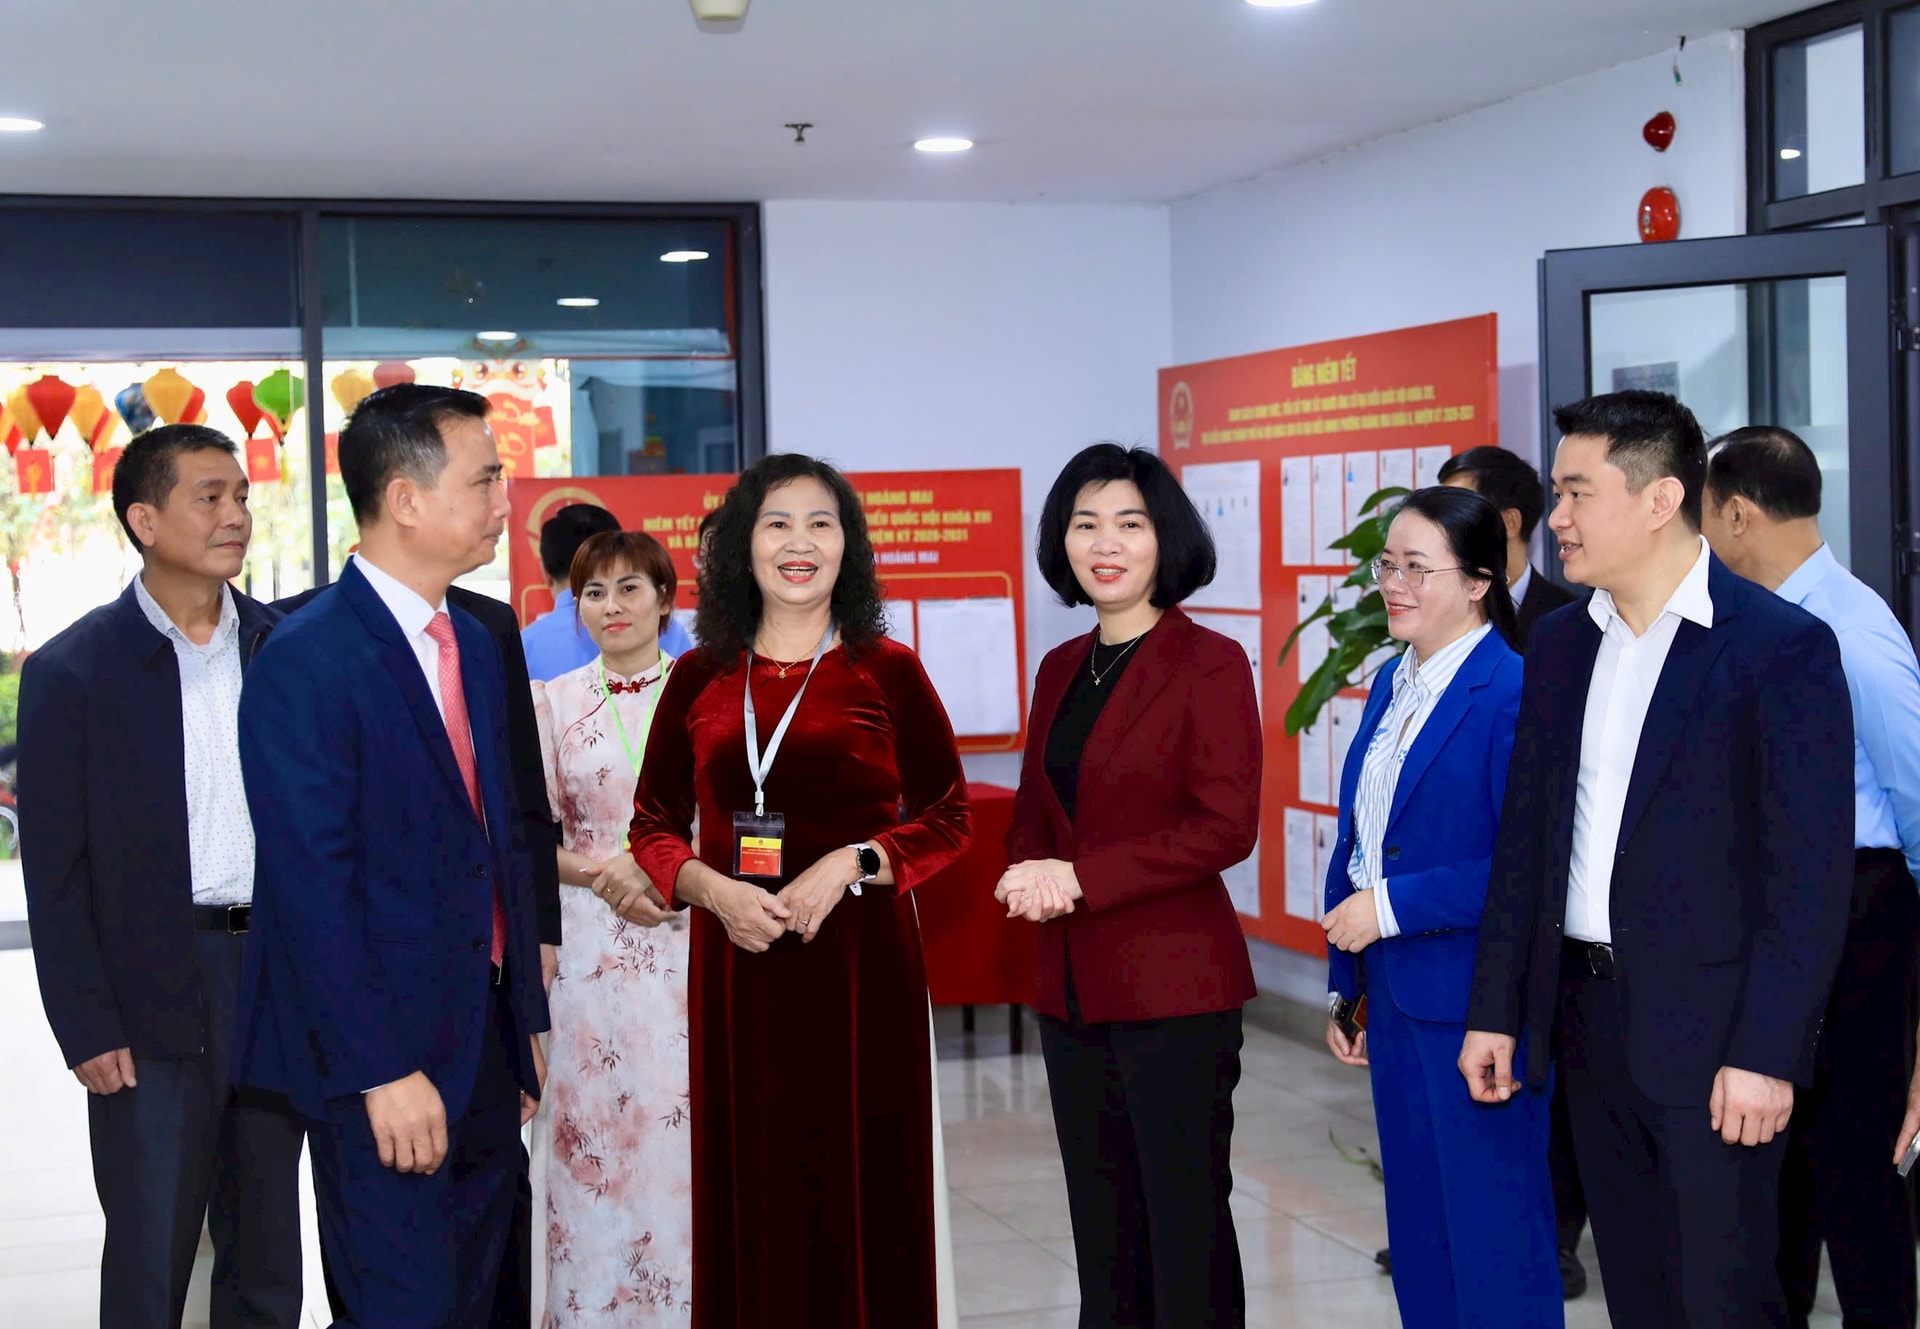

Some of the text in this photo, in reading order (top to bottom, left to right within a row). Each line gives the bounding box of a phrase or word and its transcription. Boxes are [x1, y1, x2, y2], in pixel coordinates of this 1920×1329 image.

[1292, 351, 1357, 388] BẢNG NIÊM YẾT
[866, 488, 907, 505] HOÀNG
[909, 490, 933, 504] MAI
[643, 515, 672, 531] NIÊM
[675, 512, 695, 531] YẾT
[890, 509, 919, 527] QUỐC
[921, 510, 940, 526] HỘI
[942, 508, 971, 523] KHÓA
[896, 528, 911, 543] KỲ
[880, 549, 916, 564] HOÀNG
[918, 550, 939, 564] MAI
